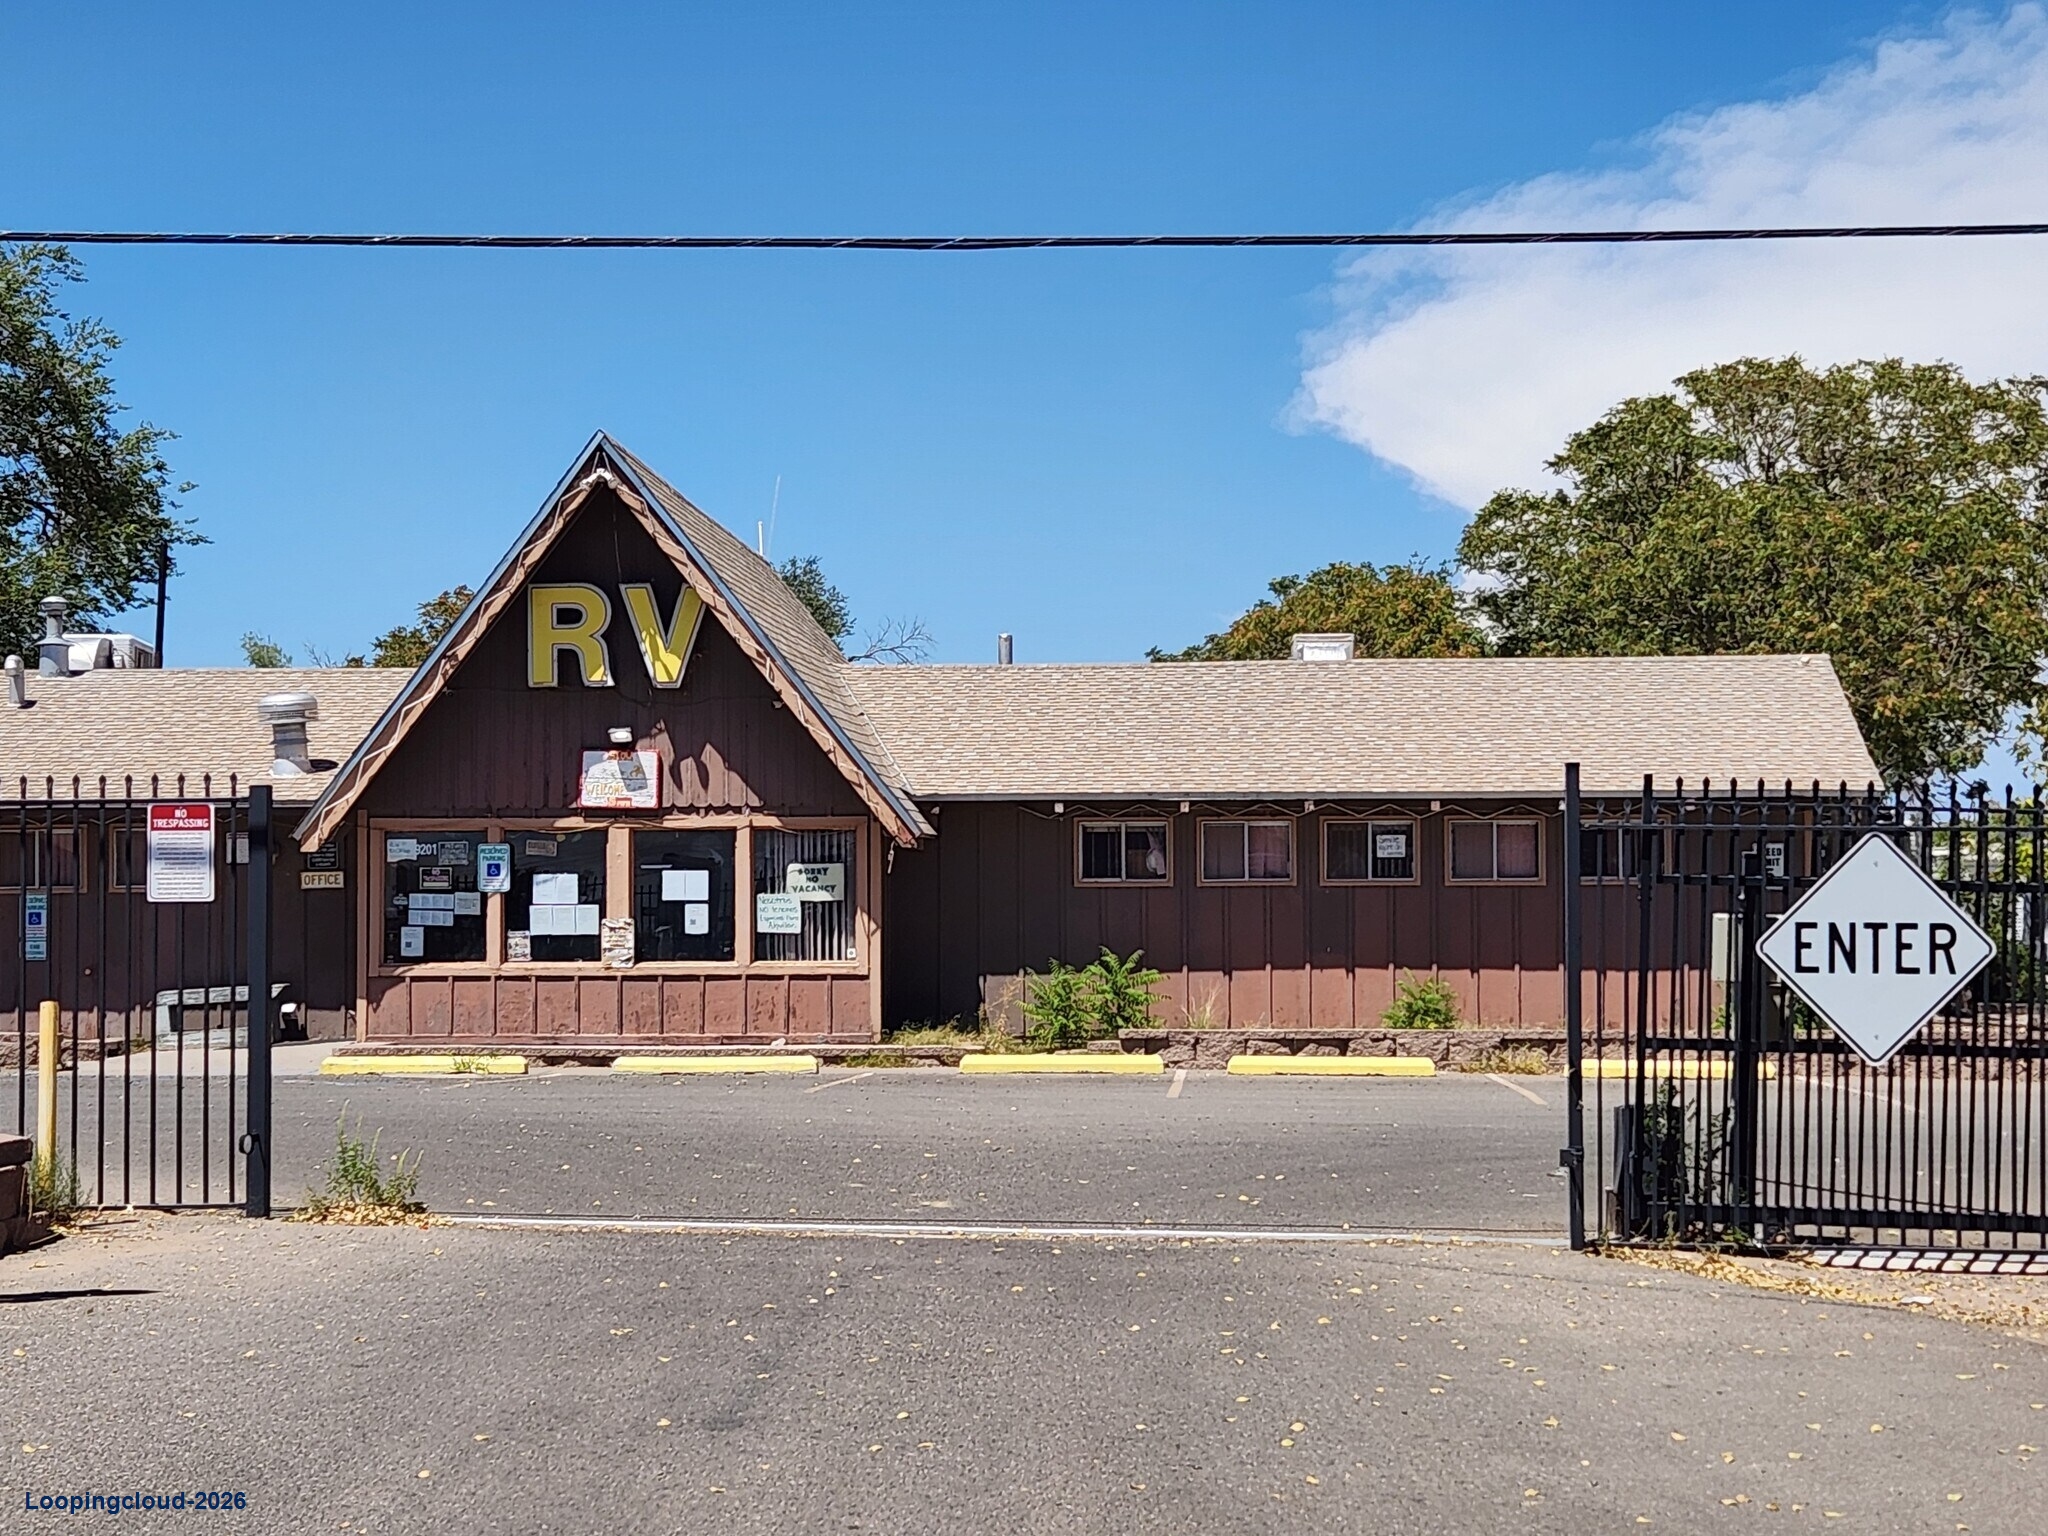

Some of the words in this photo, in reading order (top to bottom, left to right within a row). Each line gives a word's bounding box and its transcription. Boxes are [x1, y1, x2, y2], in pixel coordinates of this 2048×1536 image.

[528, 583, 706, 689] RV
[174, 809, 188, 818] NO
[153, 818, 209, 828] TRESPASSING
[415, 843, 437, 855] 9201
[798, 867, 830, 876] SORRY
[304, 873, 341, 885] OFFICE
[806, 875, 819, 883] NO
[791, 884, 837, 893] VACANCY
[1794, 922, 1957, 975] ENTER
